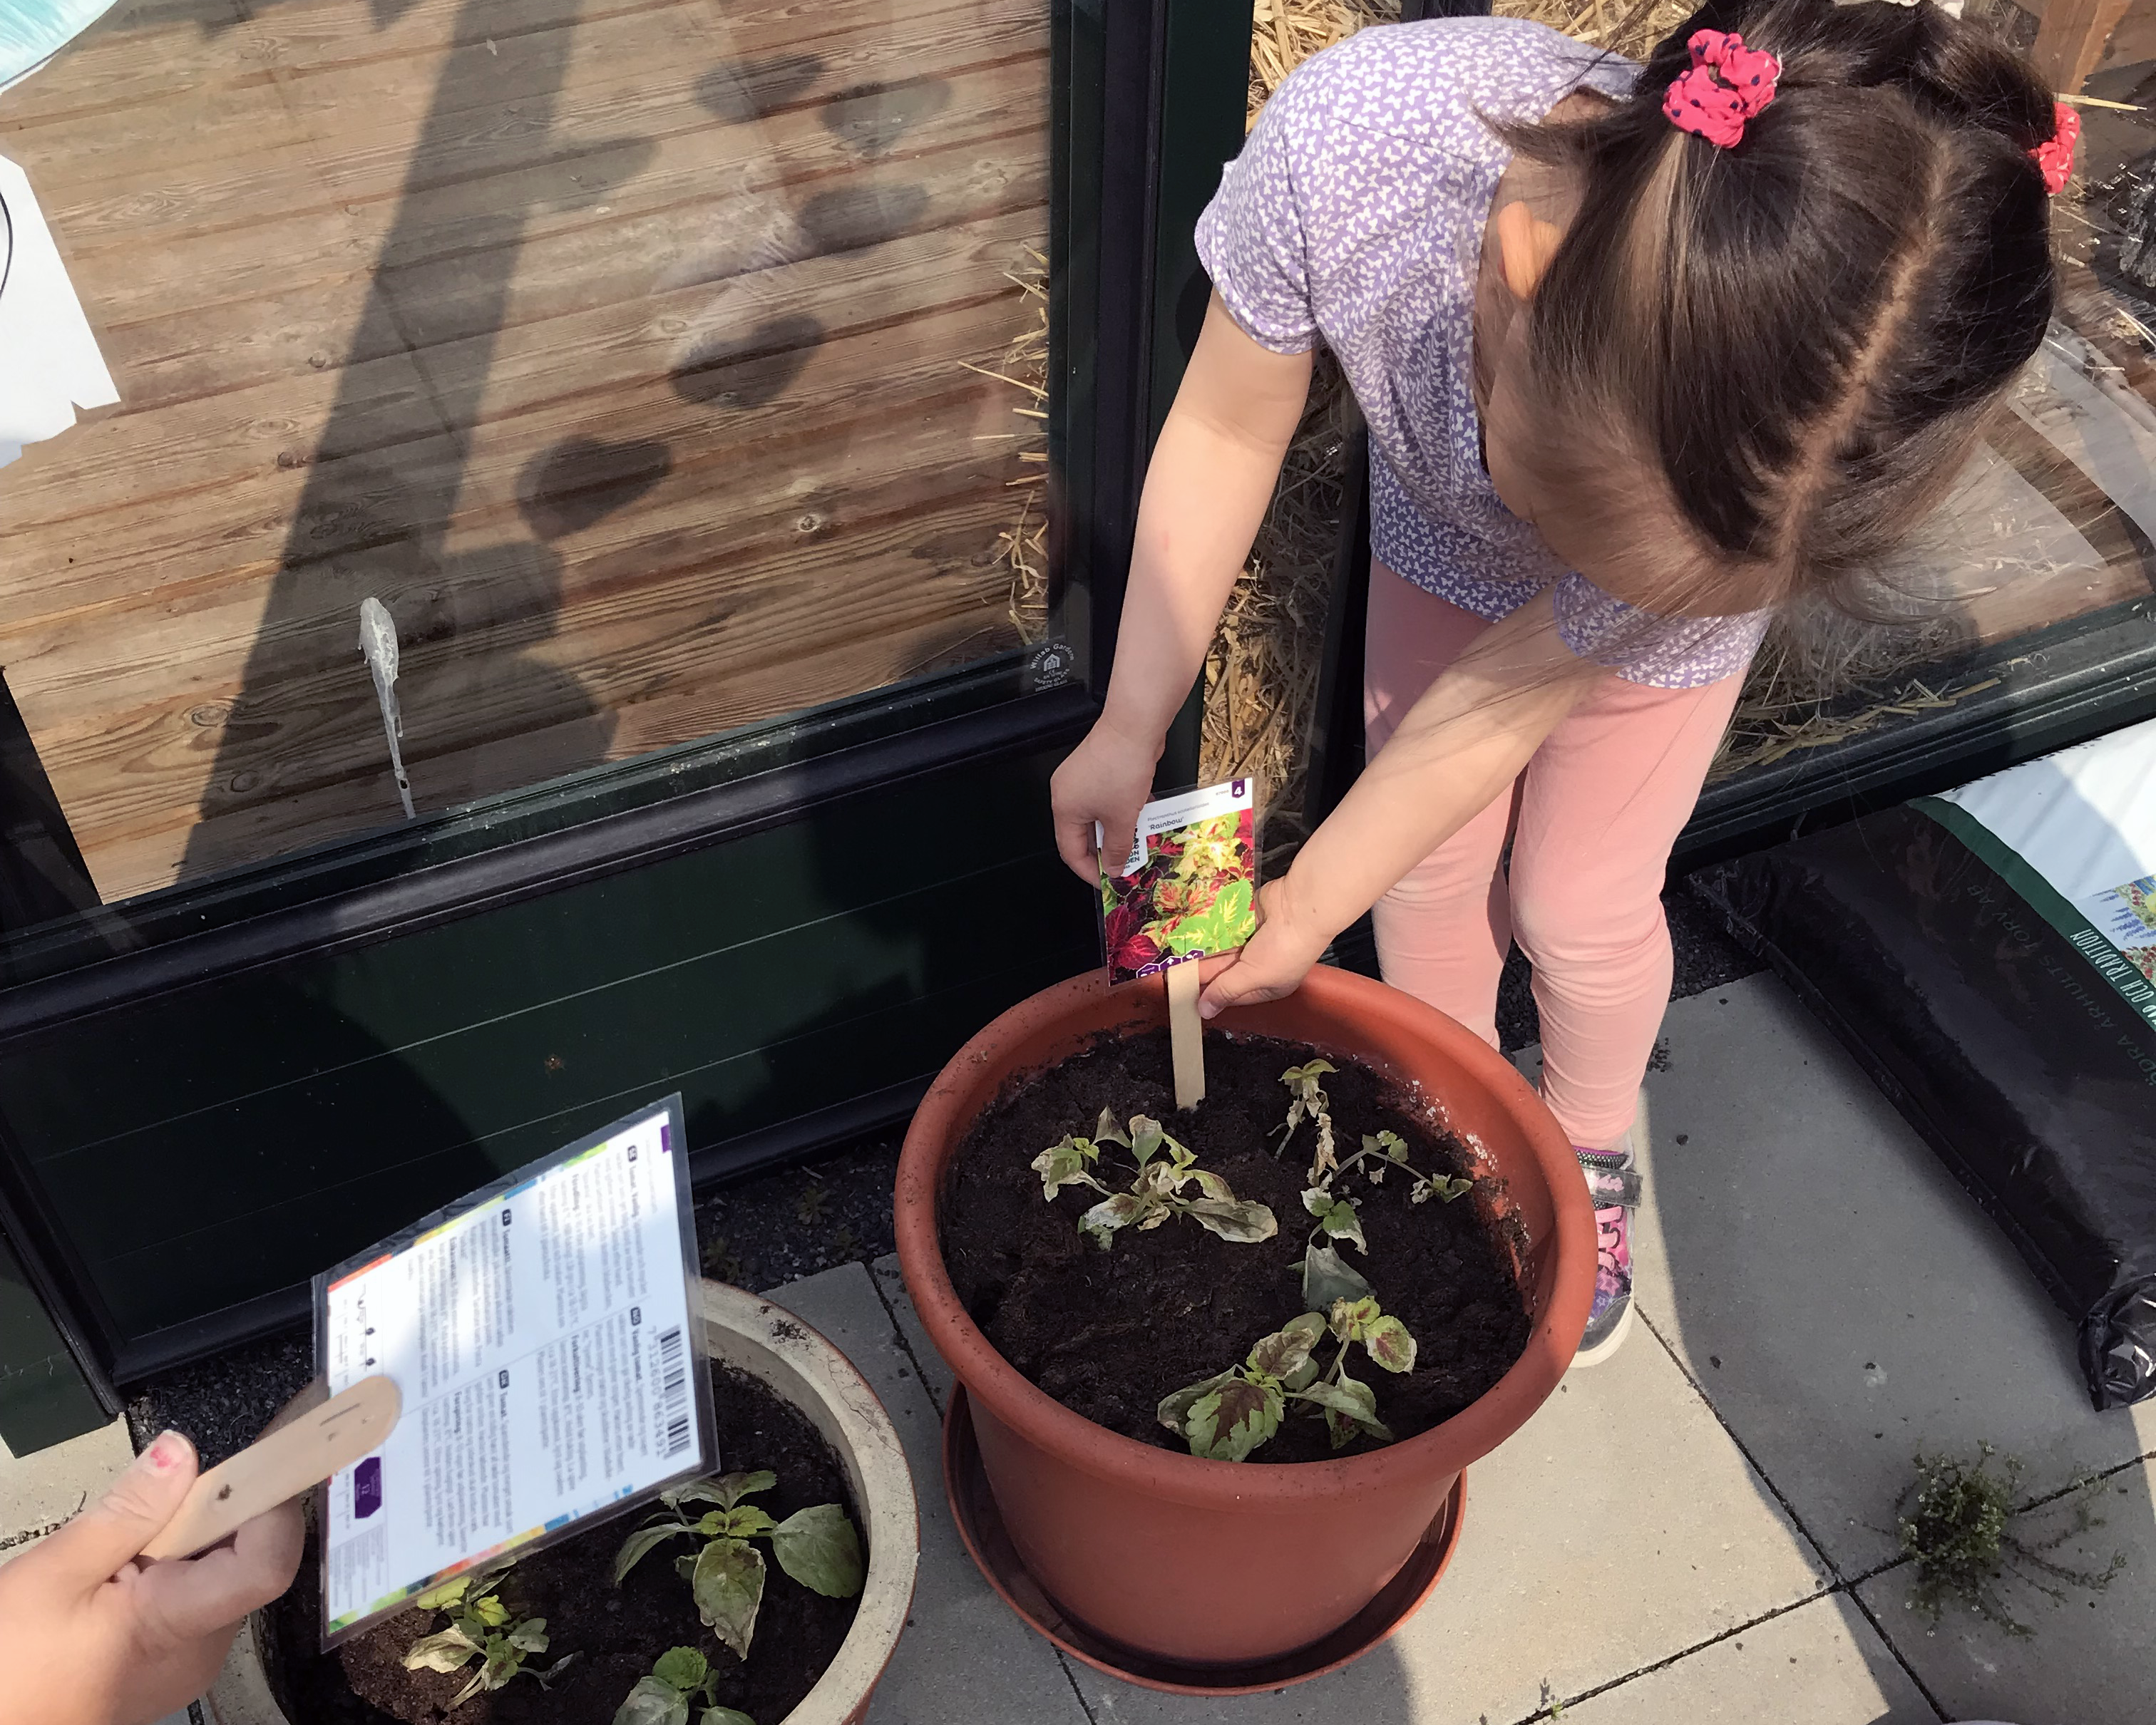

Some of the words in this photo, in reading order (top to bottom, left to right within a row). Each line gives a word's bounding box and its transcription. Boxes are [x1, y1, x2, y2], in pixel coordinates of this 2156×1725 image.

[1233, 786, 1242, 795] 4
[1967, 885, 1995, 904] AB
[2070, 929, 2132, 982] TRADITION
[2038, 954, 2119, 1030] ÅRHULTS
[2120, 979, 2154, 1003] OCH
